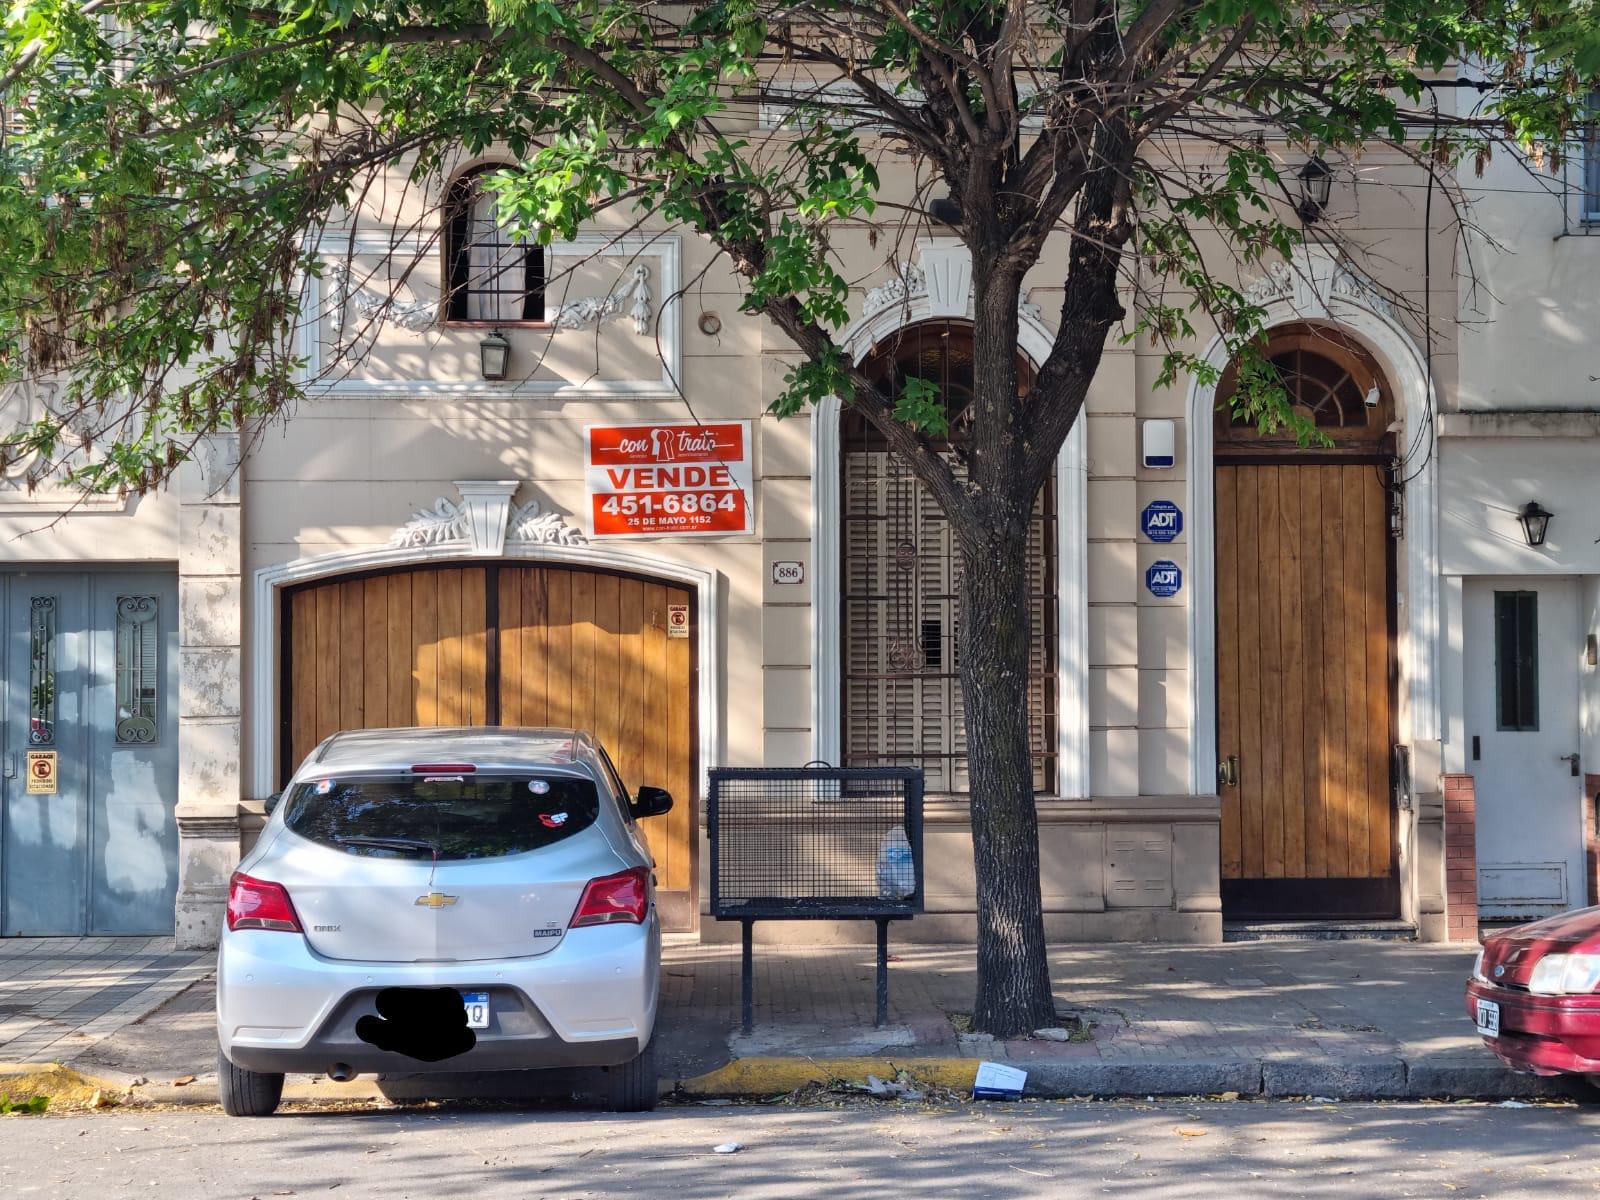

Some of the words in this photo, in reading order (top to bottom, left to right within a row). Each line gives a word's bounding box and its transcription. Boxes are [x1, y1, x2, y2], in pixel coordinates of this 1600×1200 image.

[619, 439, 649, 453] con
[676, 430, 716, 451] trato
[607, 466, 730, 489] VENDE
[601, 493, 736, 516] 451-6864
[628, 518, 640, 526] 25
[642, 517, 656, 525] DE
[659, 516, 686, 524] MAYO
[1148, 512, 1177, 527] ADT
[779, 567, 798, 578] 886
[1152, 570, 1177, 583] ADT
